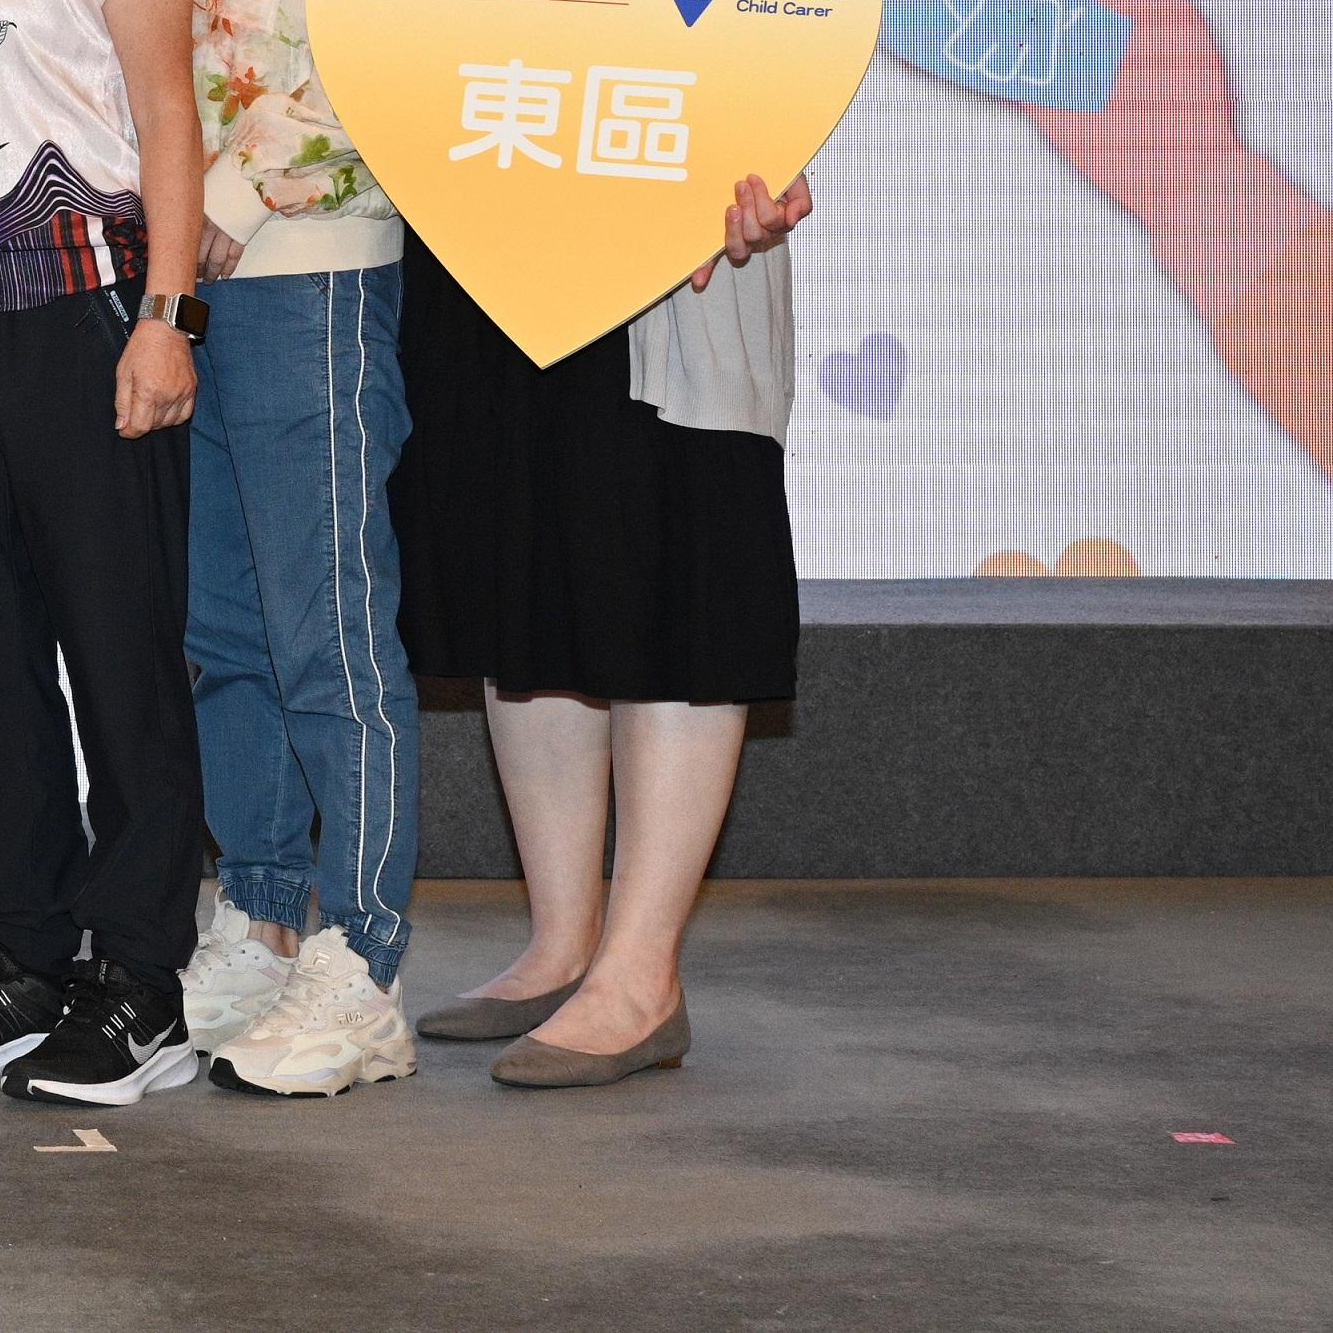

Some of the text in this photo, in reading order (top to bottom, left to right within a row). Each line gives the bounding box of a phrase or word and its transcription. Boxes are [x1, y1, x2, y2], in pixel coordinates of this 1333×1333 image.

[736, 0, 833, 17] Child Carer
[448, 59, 698, 182] 東區
